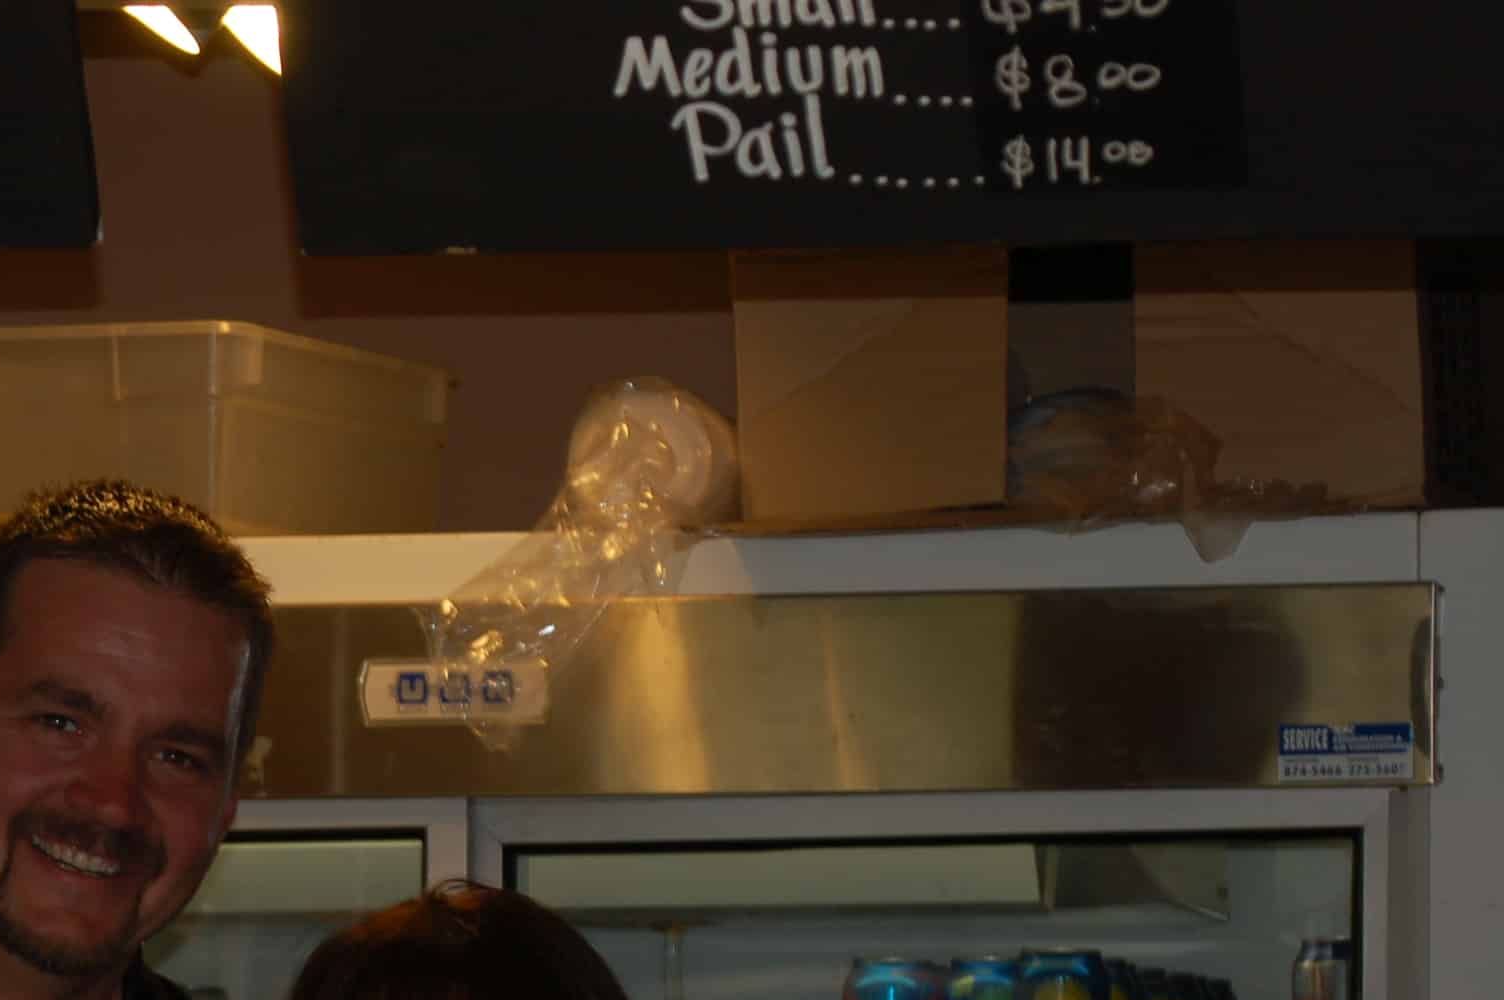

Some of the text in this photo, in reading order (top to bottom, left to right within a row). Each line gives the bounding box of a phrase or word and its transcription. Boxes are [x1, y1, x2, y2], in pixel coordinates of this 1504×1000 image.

[613, 26, 885, 98] Medium
[670, 93, 836, 183] Pail
[1282, 726, 1329, 753] SERVICE
